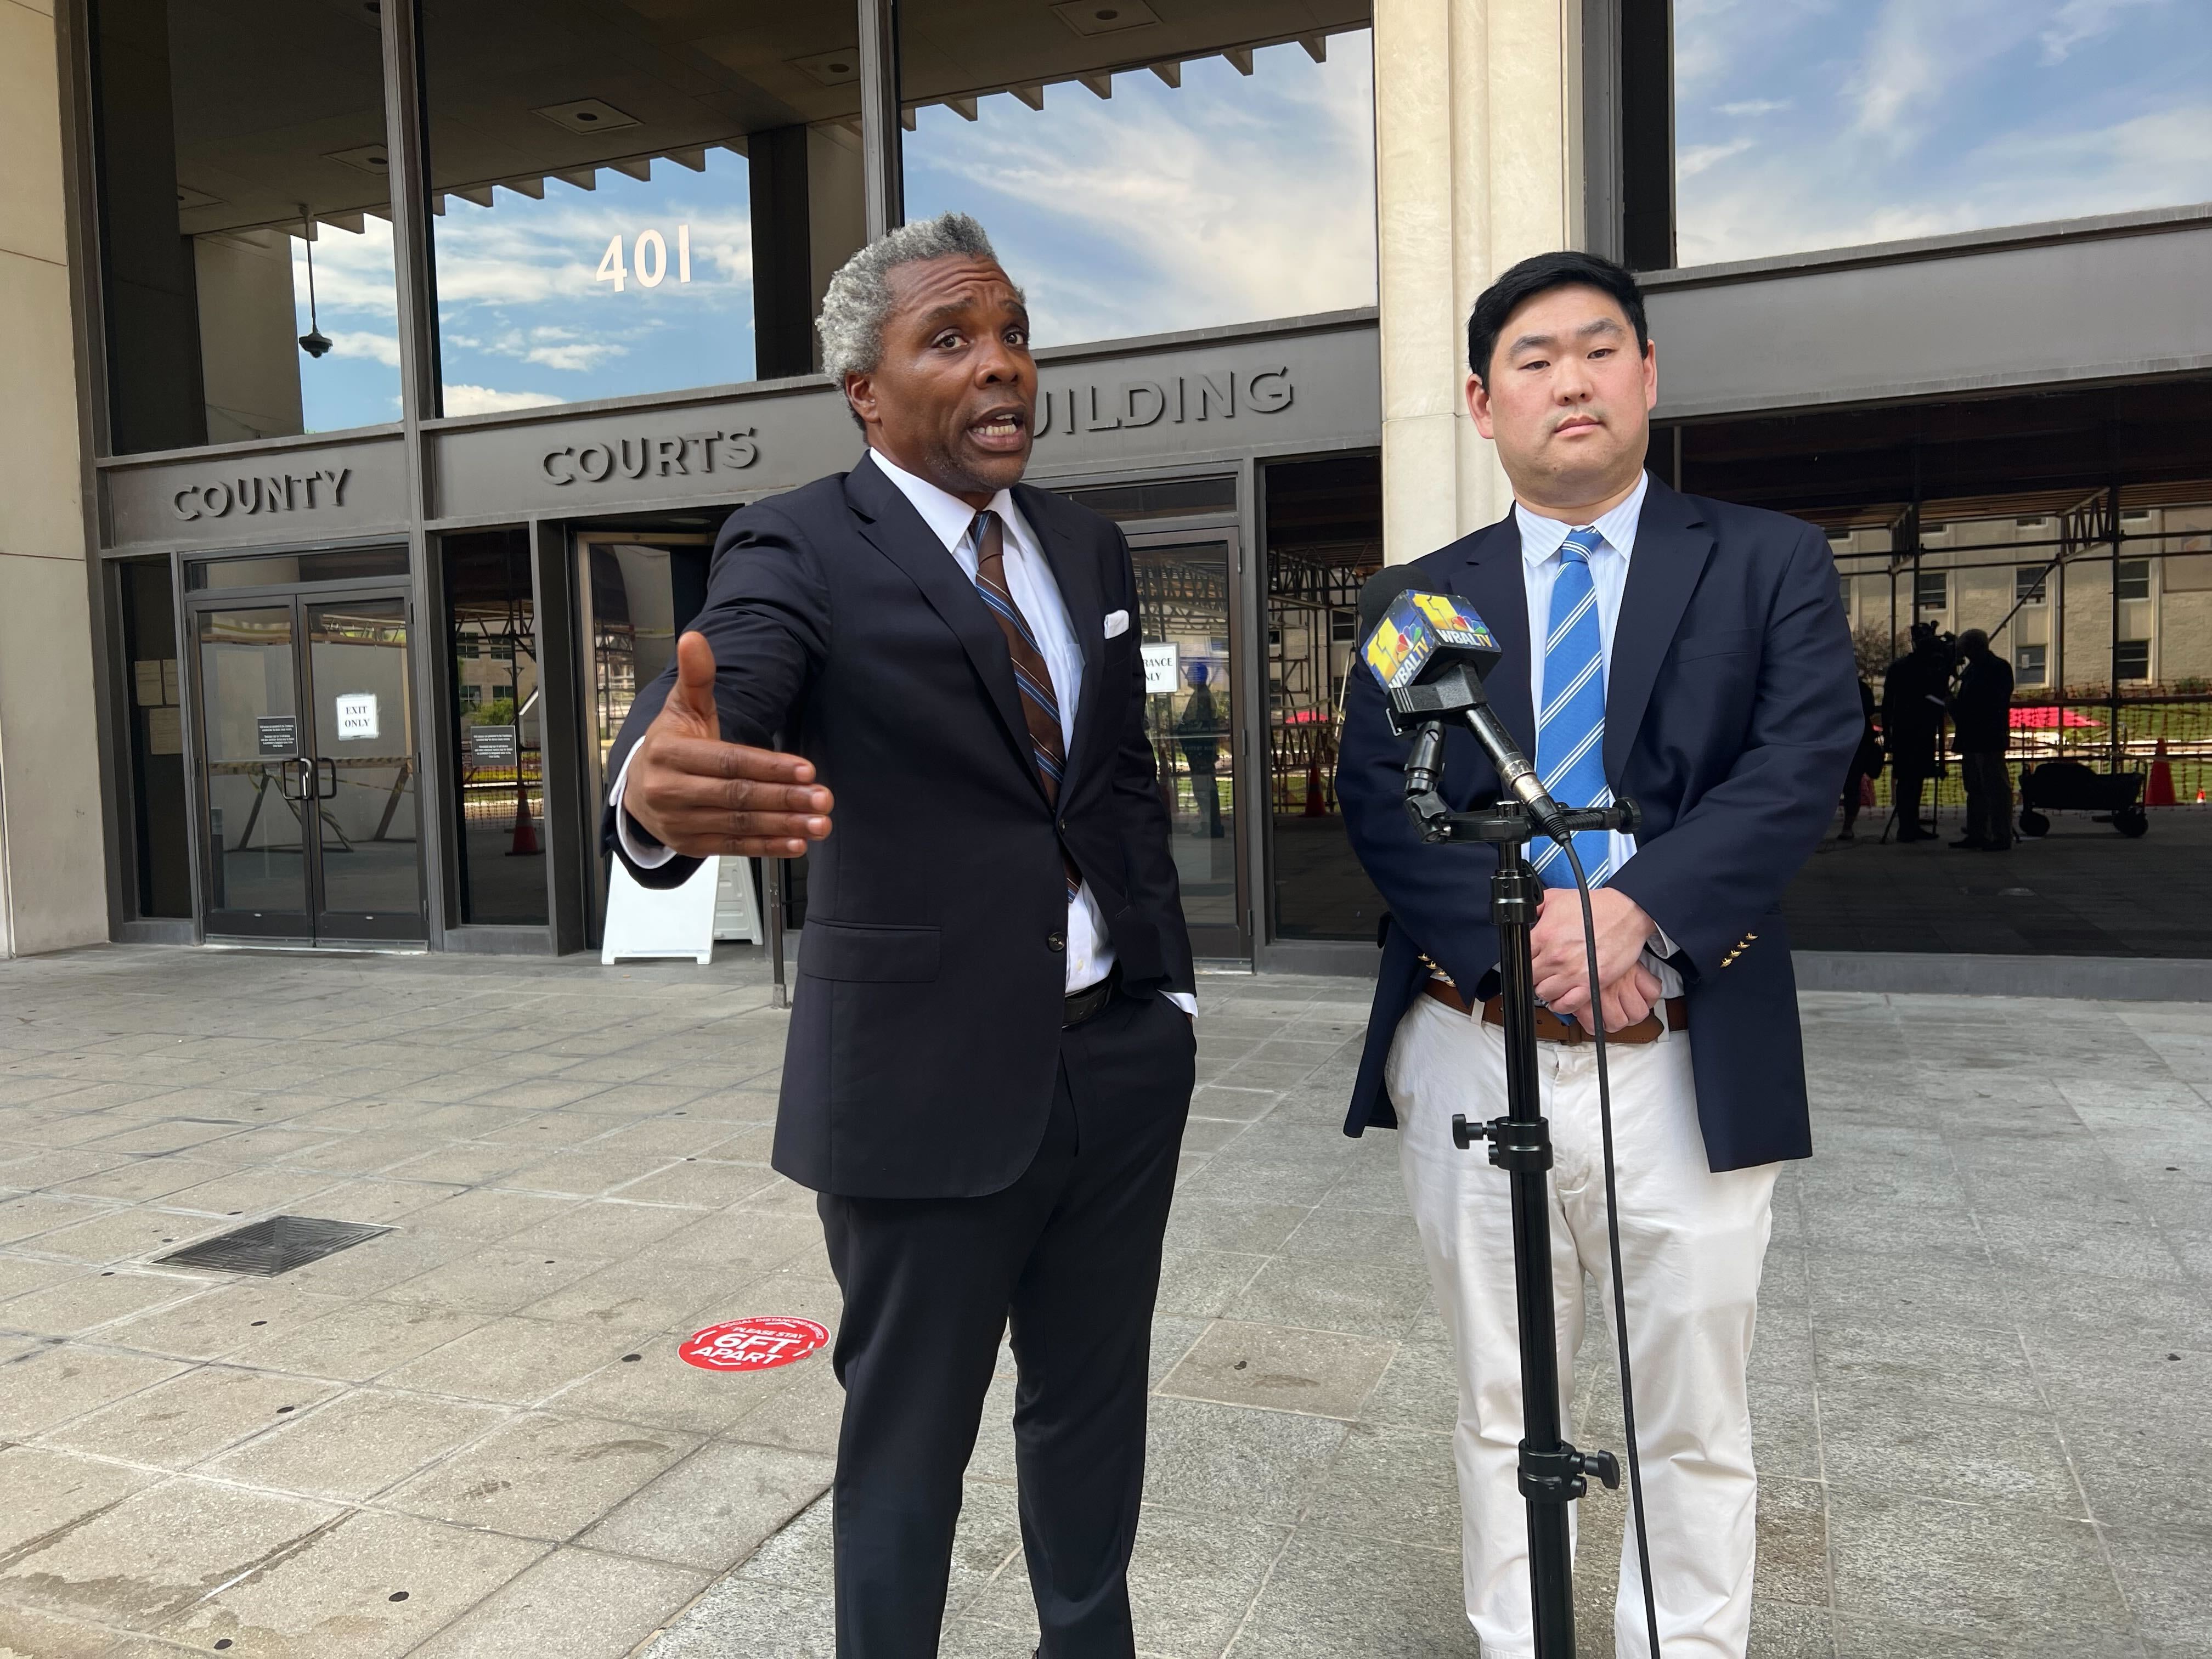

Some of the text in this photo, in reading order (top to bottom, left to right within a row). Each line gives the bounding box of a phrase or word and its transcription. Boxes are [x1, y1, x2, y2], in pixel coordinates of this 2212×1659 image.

[596, 224, 691, 292] 401
[172, 366, 1294, 521] COUNTY COURTS UILDING
[1143, 658, 1172, 667] RANCE
[1146, 672, 1161, 681] NLY
[346, 706, 368, 714] EXIT
[345, 719, 370, 727] ONLY
[719, 1319, 753, 1328] SOCIAL
[732, 1327, 777, 1336] PLEASE
[714, 1333, 802, 1354] 6FT
[690, 1346, 783, 1364] APART
